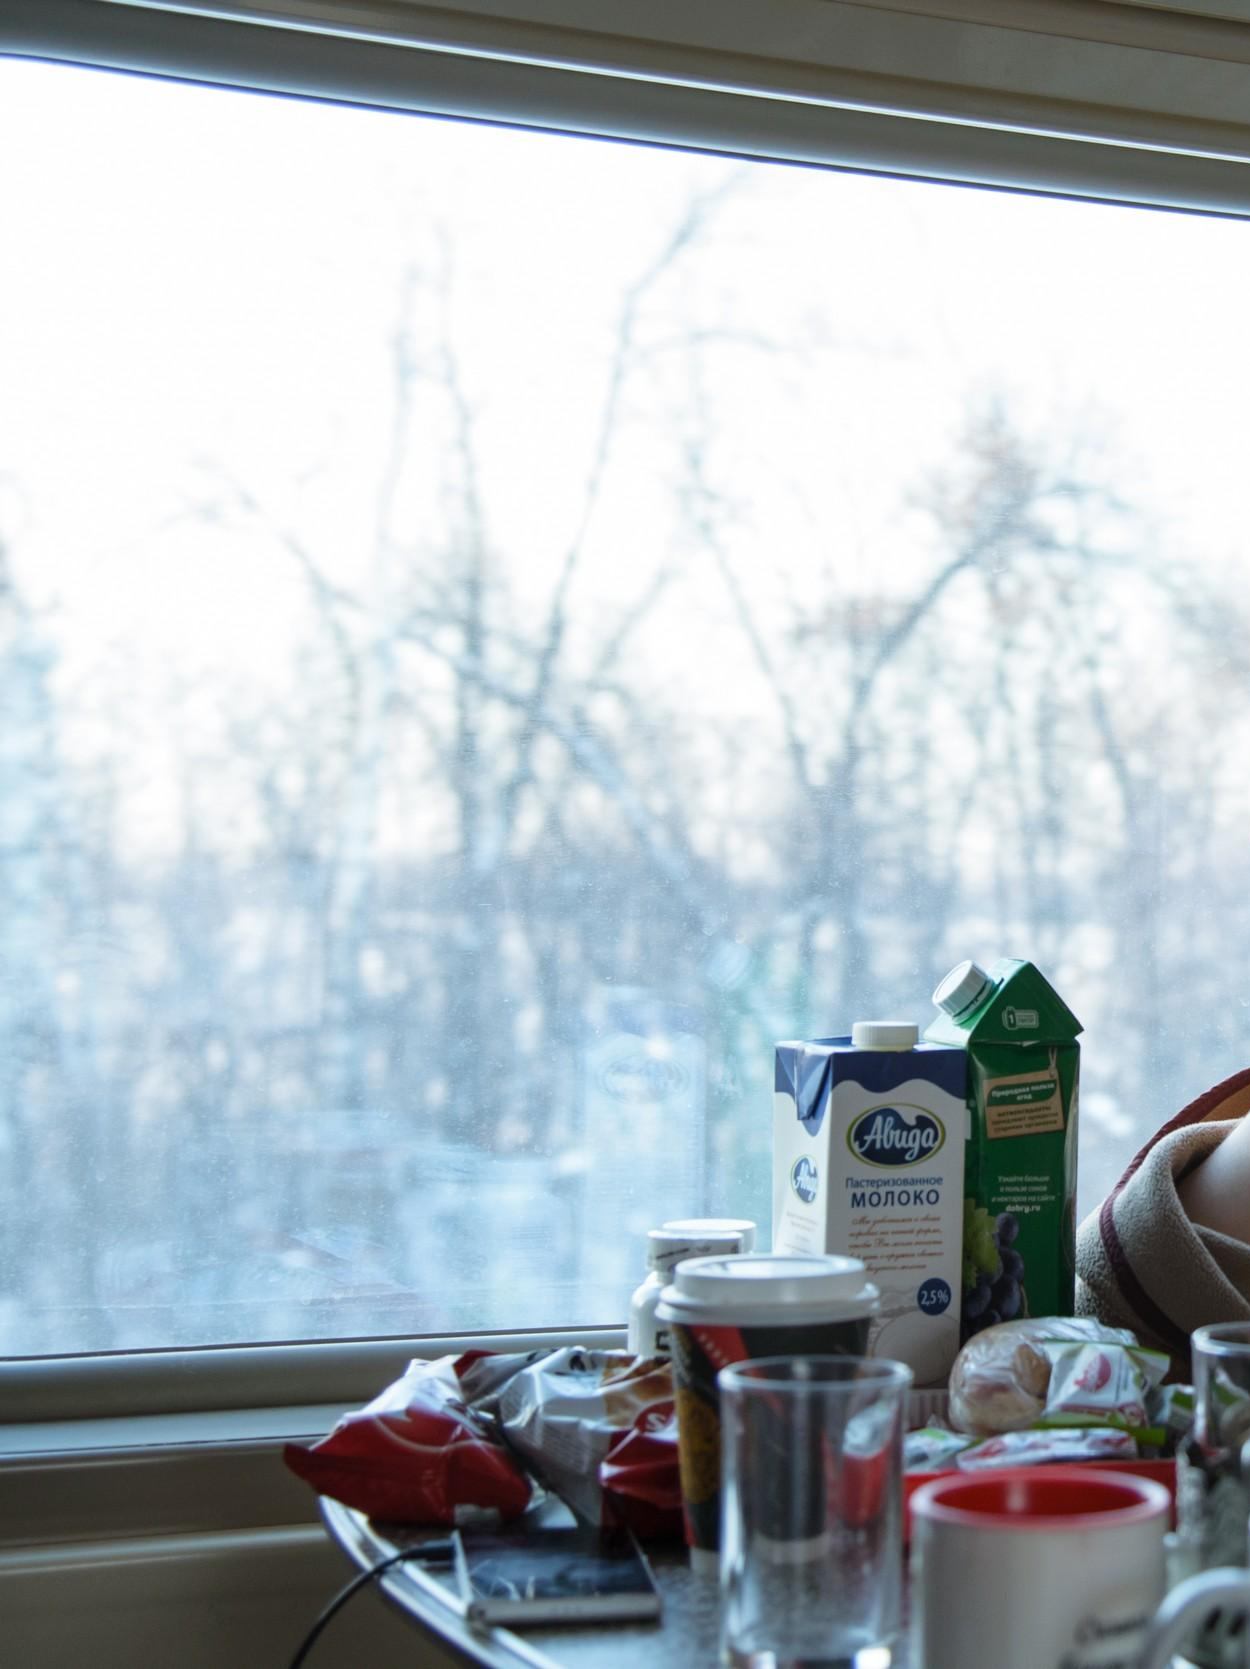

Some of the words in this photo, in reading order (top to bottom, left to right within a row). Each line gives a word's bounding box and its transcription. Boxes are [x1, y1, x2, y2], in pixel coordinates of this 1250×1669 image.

[855, 1115, 938, 1161] Авида
[845, 1176, 944, 1190] Пастеризованное
[850, 1188, 941, 1209] МОЛОКО
[1005, 1204, 1041, 1214] dobry.ru
[920, 1288, 950, 1306] 2,5%
